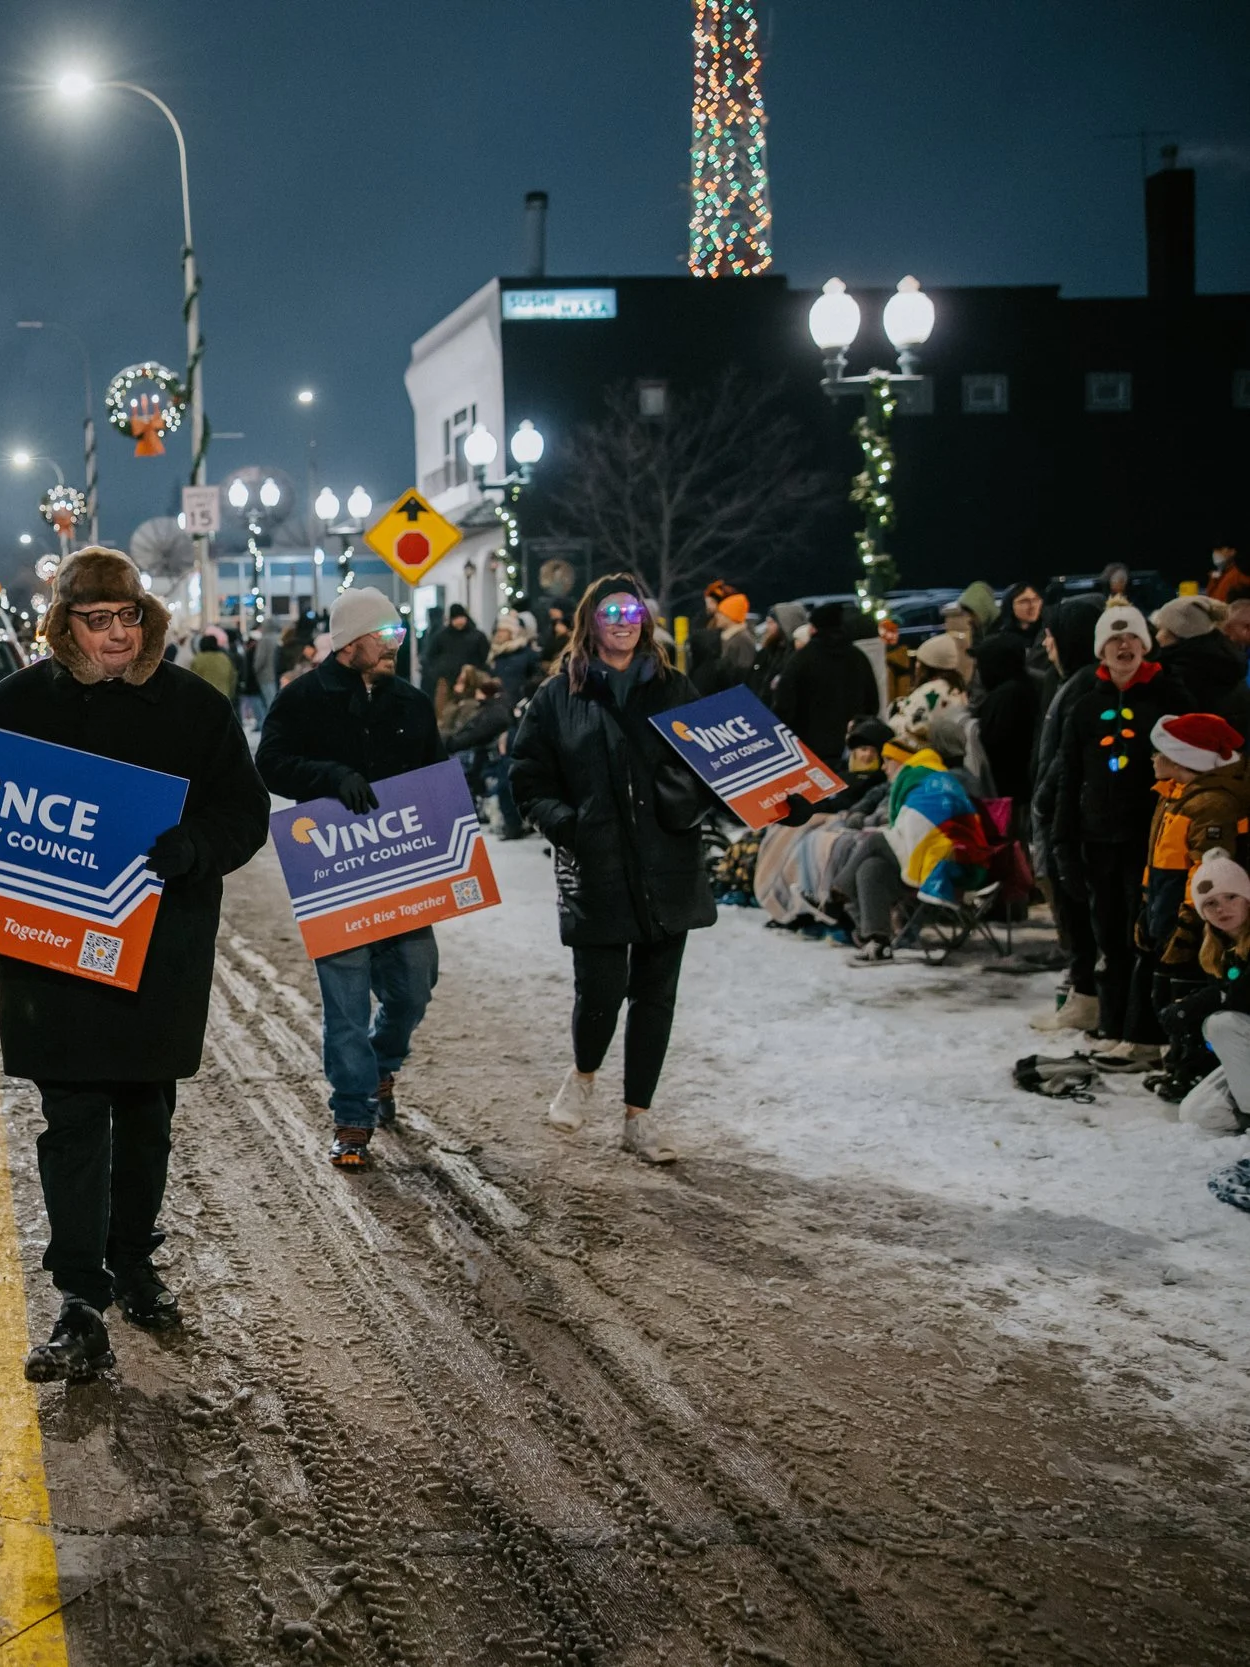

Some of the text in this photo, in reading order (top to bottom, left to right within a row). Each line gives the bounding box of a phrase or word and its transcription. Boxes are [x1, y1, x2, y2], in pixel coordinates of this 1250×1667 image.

[190, 510, 212, 527] 15
[686, 715, 758, 753] VINCE
[720, 751, 740, 764] CITY
[738, 738, 775, 757] COUNCIL
[6, 831, 99, 870] COUNCIL
[308, 805, 423, 858] VINCE
[313, 835, 437, 882] for CITY COUNCIL
[3, 917, 72, 949] Together
[344, 917, 371, 934] Let's
[373, 910, 396, 925] Rise
[398, 894, 447, 917] Together
